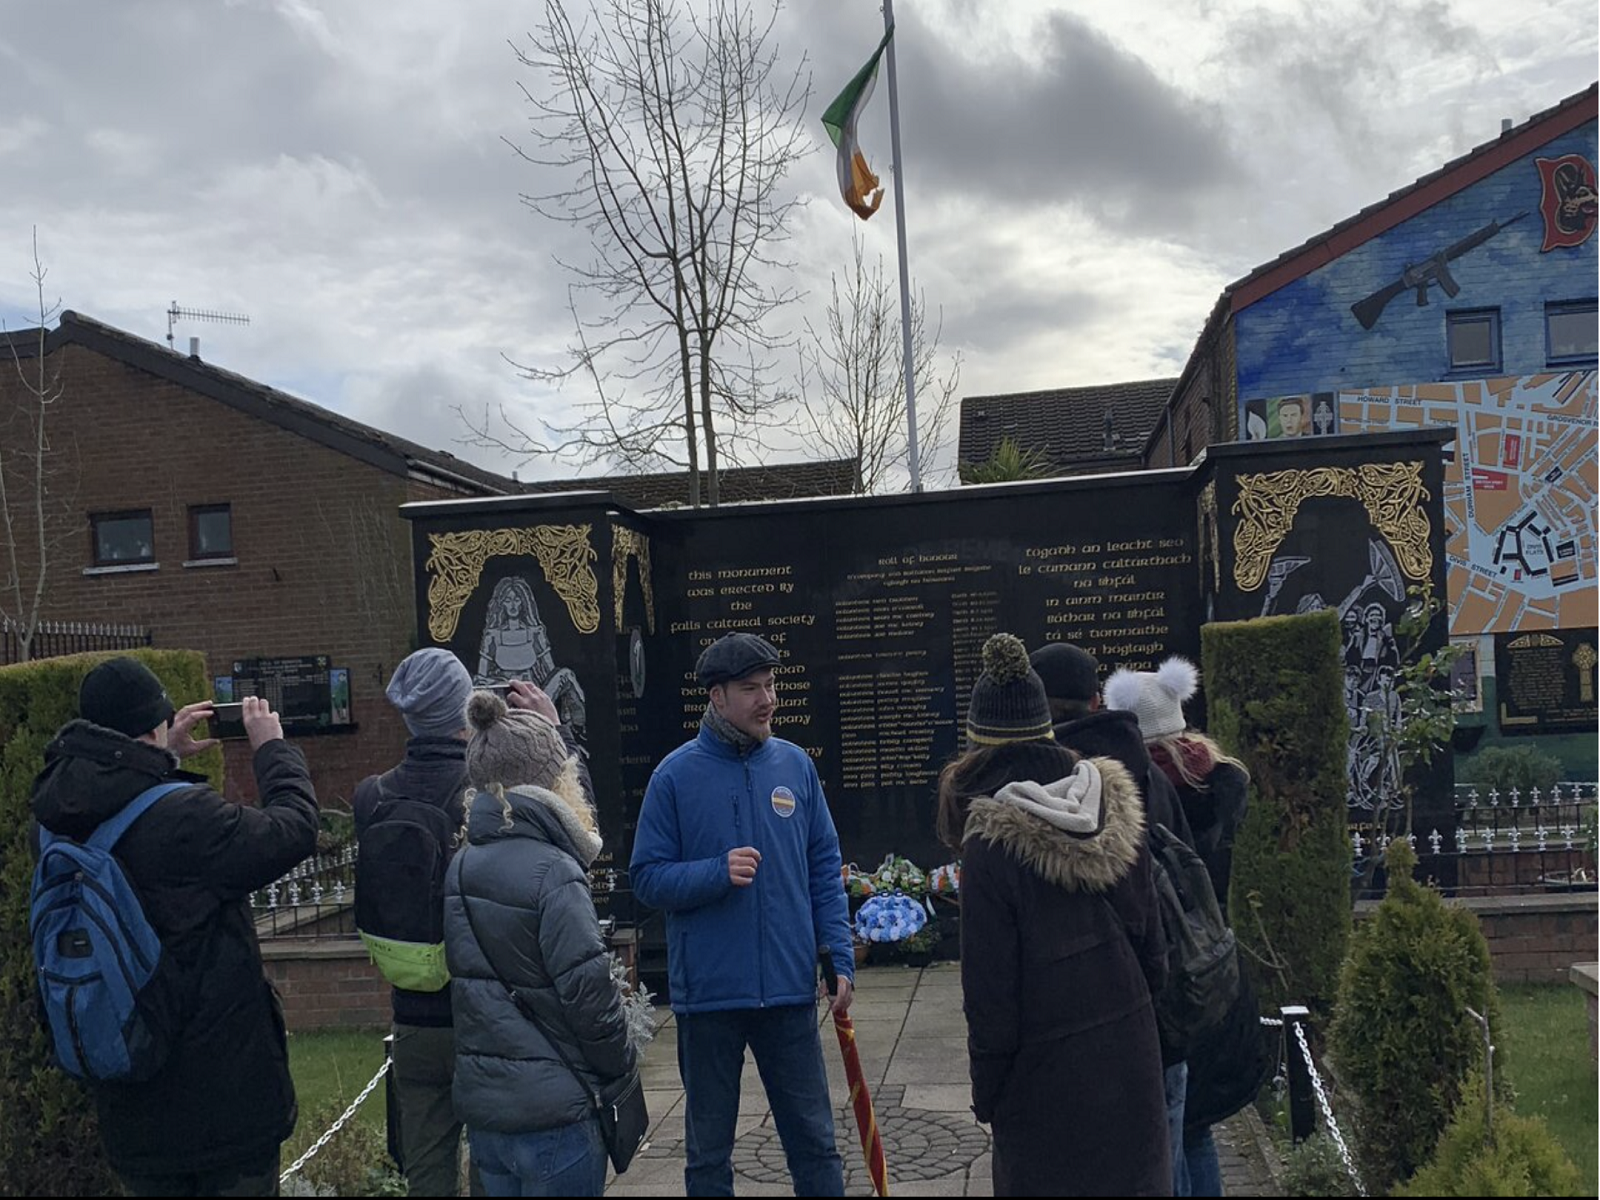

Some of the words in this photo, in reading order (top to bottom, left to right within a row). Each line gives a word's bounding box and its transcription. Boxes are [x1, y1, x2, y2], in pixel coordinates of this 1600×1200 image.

[1357, 395, 1390, 404] HOWARD
[1394, 398, 1422, 407] STREET
[1547, 413, 1592, 425] GROSVENOR
[1462, 452, 1472, 480] STREET
[1465, 485, 1476, 518] DURHAM
[1081, 544, 1100, 554] an
[1107, 539, 1153, 552] leacht
[1159, 538, 1184, 547] seo
[718, 565, 793, 579] monument
[1018, 564, 1031, 575] le
[1449, 555, 1468, 567] DIVIS
[1470, 564, 1498, 578] STREET
[730, 600, 752, 611] the
[670, 620, 701, 634] falls
[706, 615, 762, 630] cultural
[767, 613, 816, 626] society
[770, 632, 787, 645] of
[774, 697, 808, 709] llant
